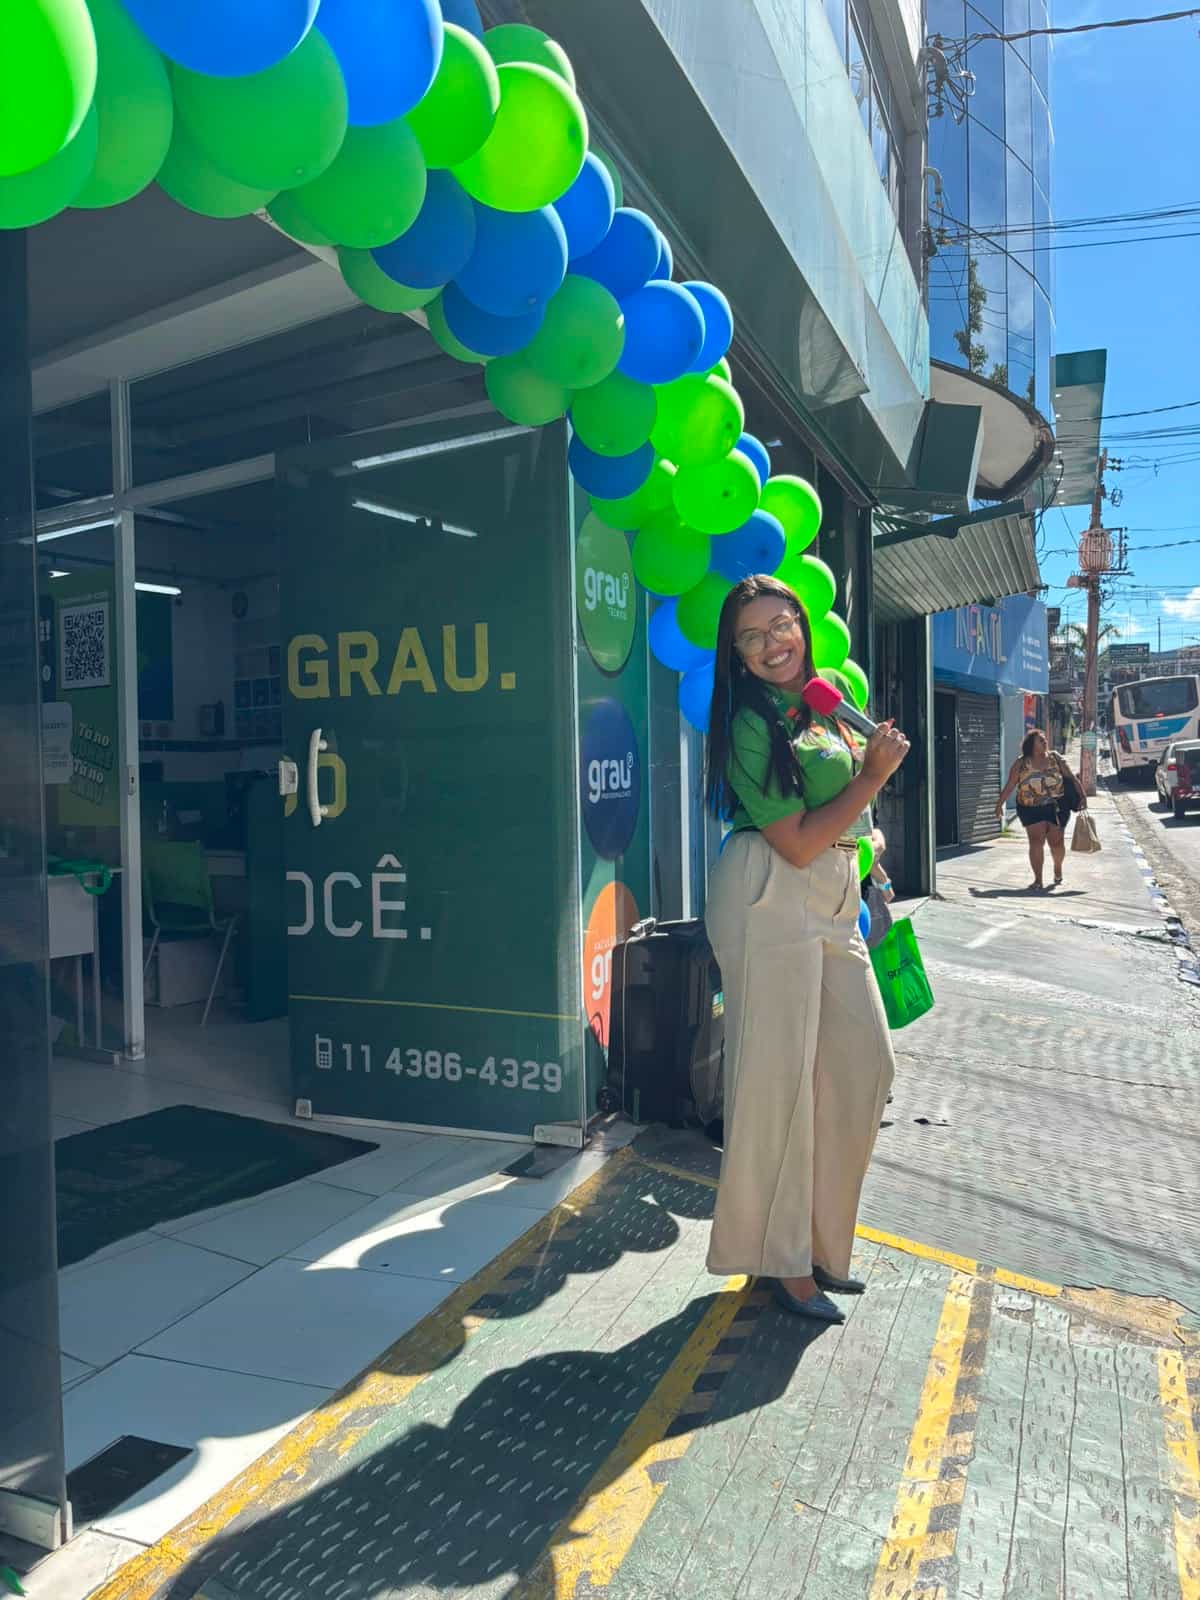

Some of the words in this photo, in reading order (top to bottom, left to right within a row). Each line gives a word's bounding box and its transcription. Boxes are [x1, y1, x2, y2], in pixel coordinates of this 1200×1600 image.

[584, 567, 627, 611] grau
[287, 622, 516, 699] GRAU.
[588, 759, 632, 804] grau
[591, 946, 613, 1001] gr
[342, 1043, 371, 1073] 11
[385, 1047, 563, 1093] 4386-4329
